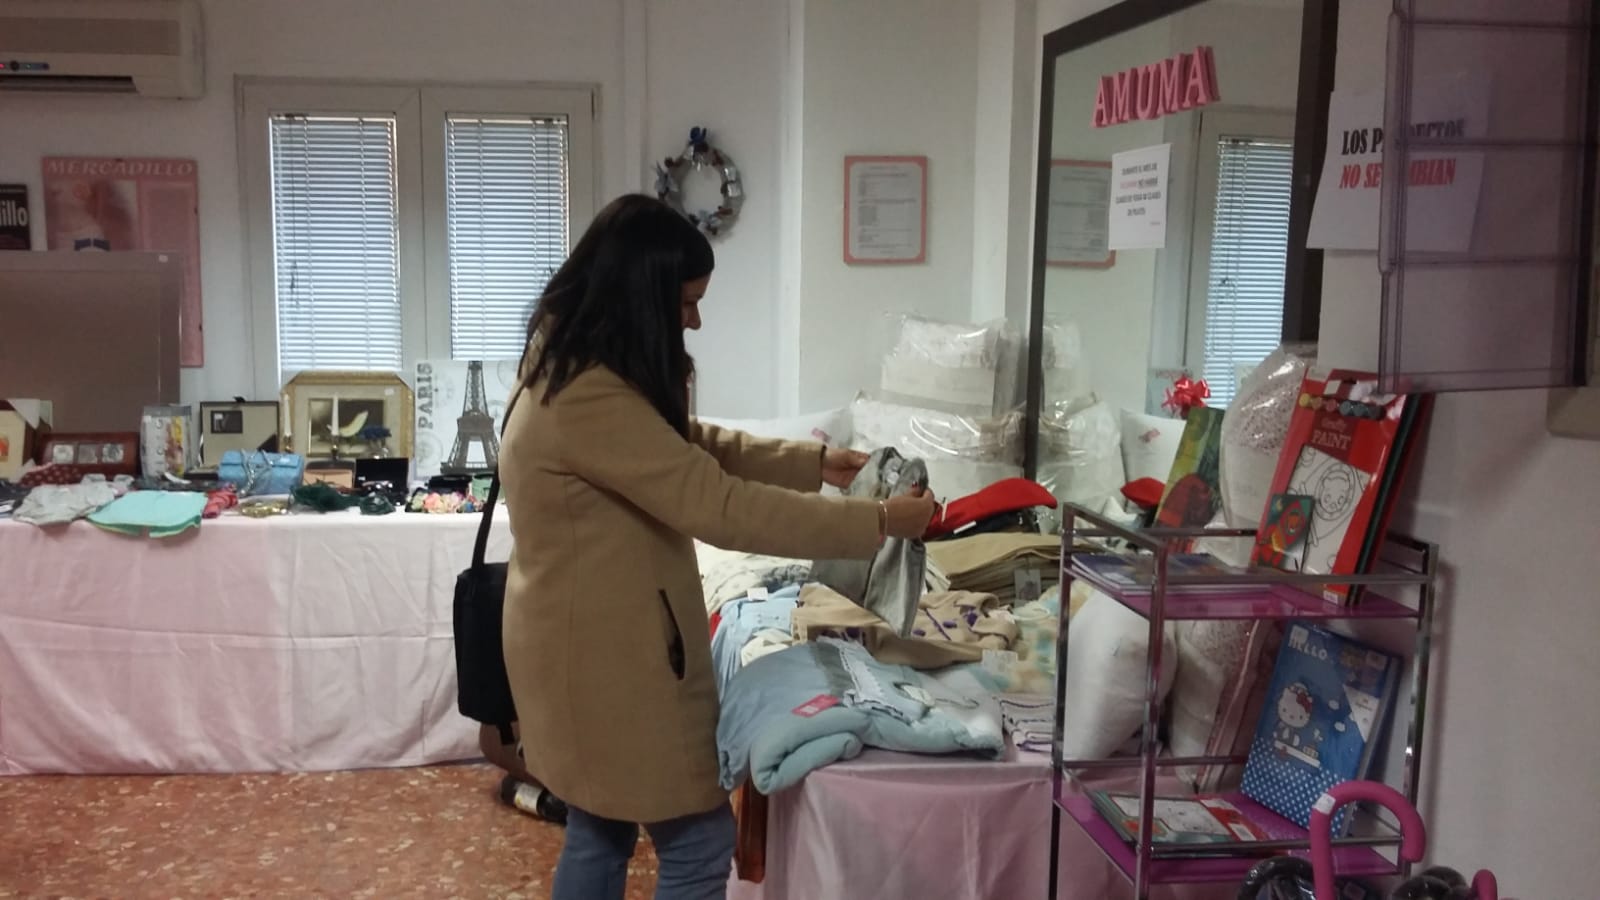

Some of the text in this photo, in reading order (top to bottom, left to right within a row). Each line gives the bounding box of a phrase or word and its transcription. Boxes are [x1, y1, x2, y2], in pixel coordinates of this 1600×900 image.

[1091, 45, 1215, 128] AMUMA
[1342, 128, 1369, 155] LOS
[49, 159, 194, 176] MERCADILLO
[1339, 164, 1361, 189] NO
[1363, 163, 1383, 188] SE
[0, 199, 29, 228] illo
[416, 362, 434, 429] PARIS
[1311, 429, 1352, 450] PAINT
